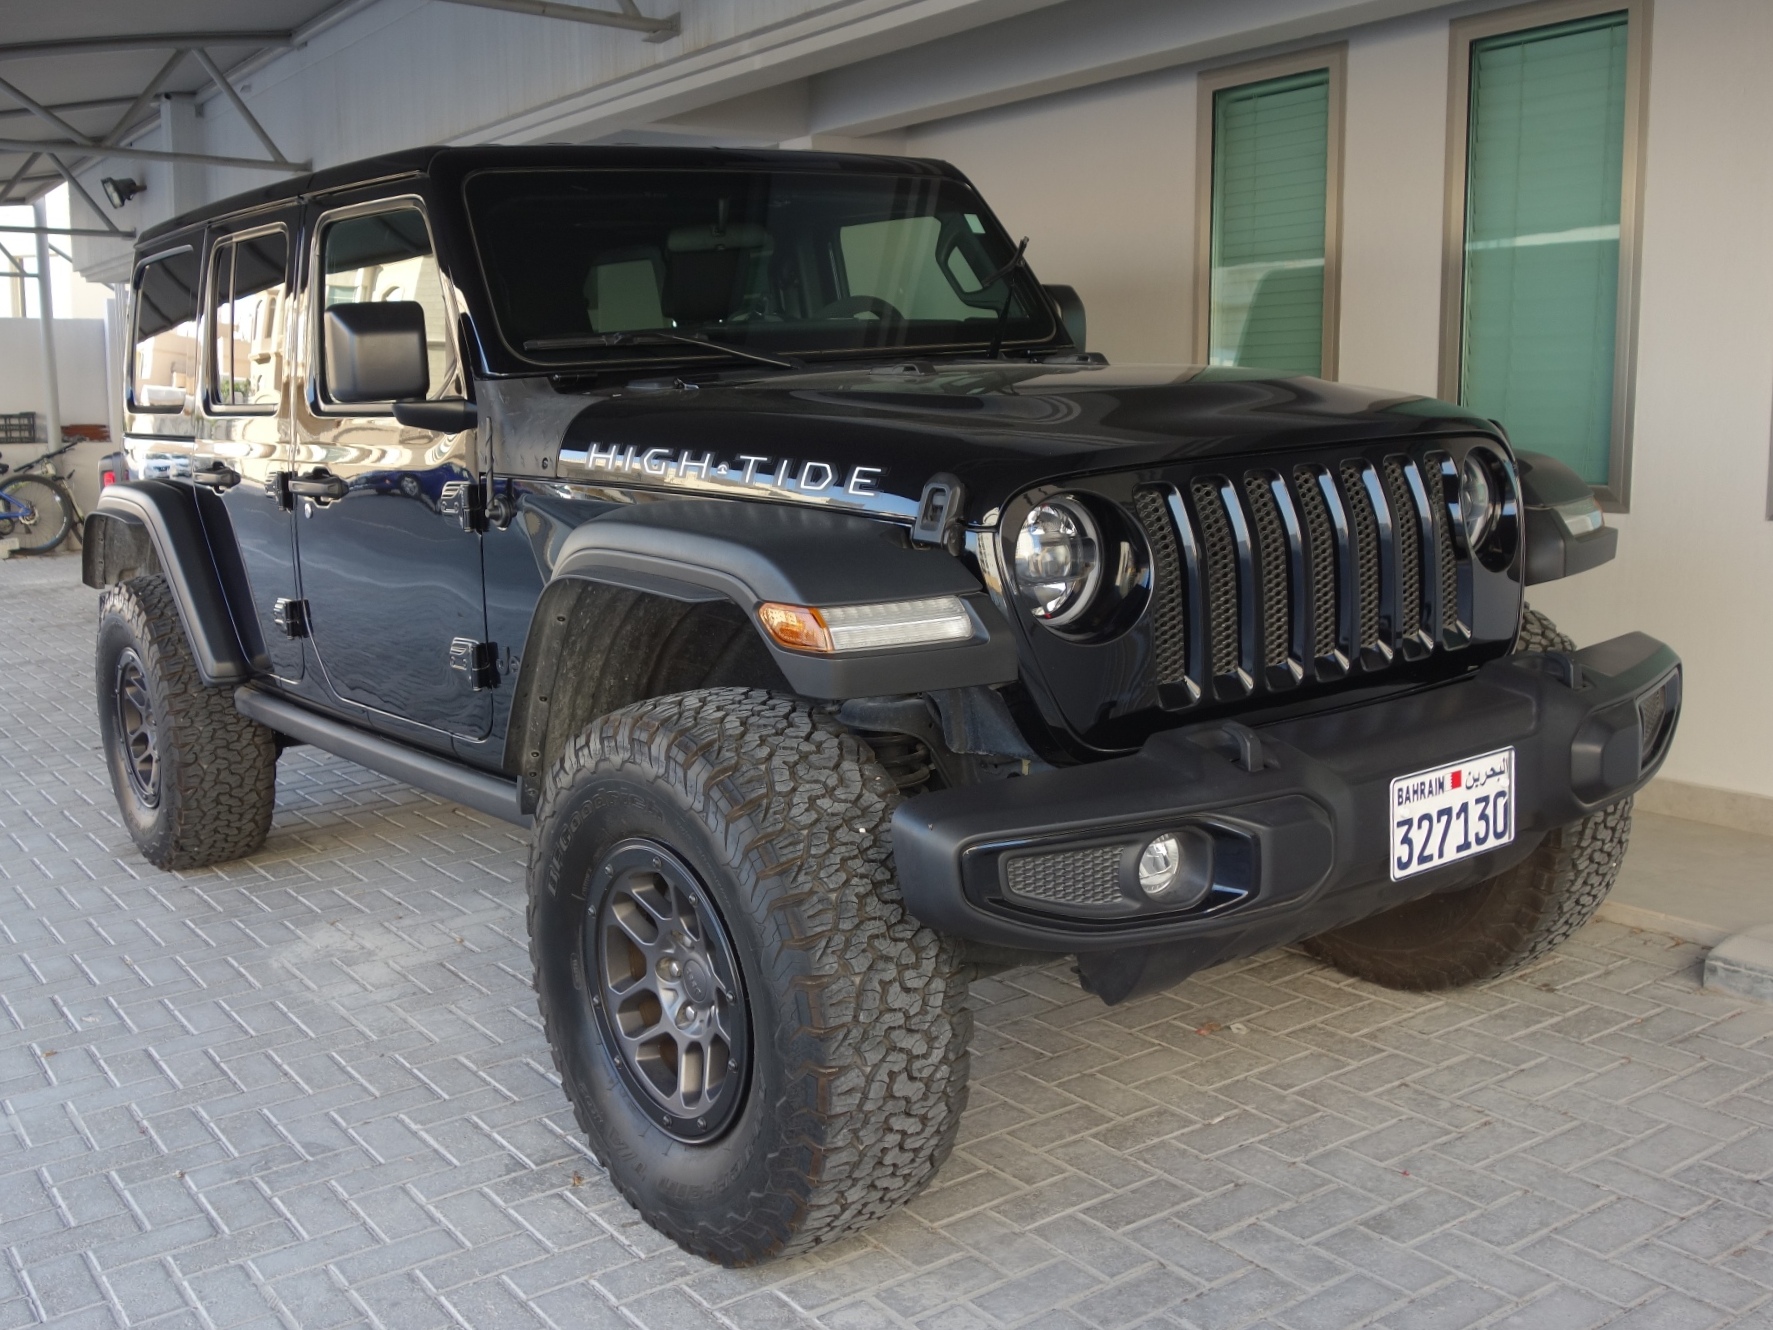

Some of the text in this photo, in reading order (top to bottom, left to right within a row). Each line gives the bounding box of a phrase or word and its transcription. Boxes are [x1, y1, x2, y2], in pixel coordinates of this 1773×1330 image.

[585, 442, 888, 497] HIGH TIDE
[1397, 775, 1445, 806] BAHRAIN
[1465, 757, 1509, 790] البحرين
[1396, 790, 1508, 871] 327130
